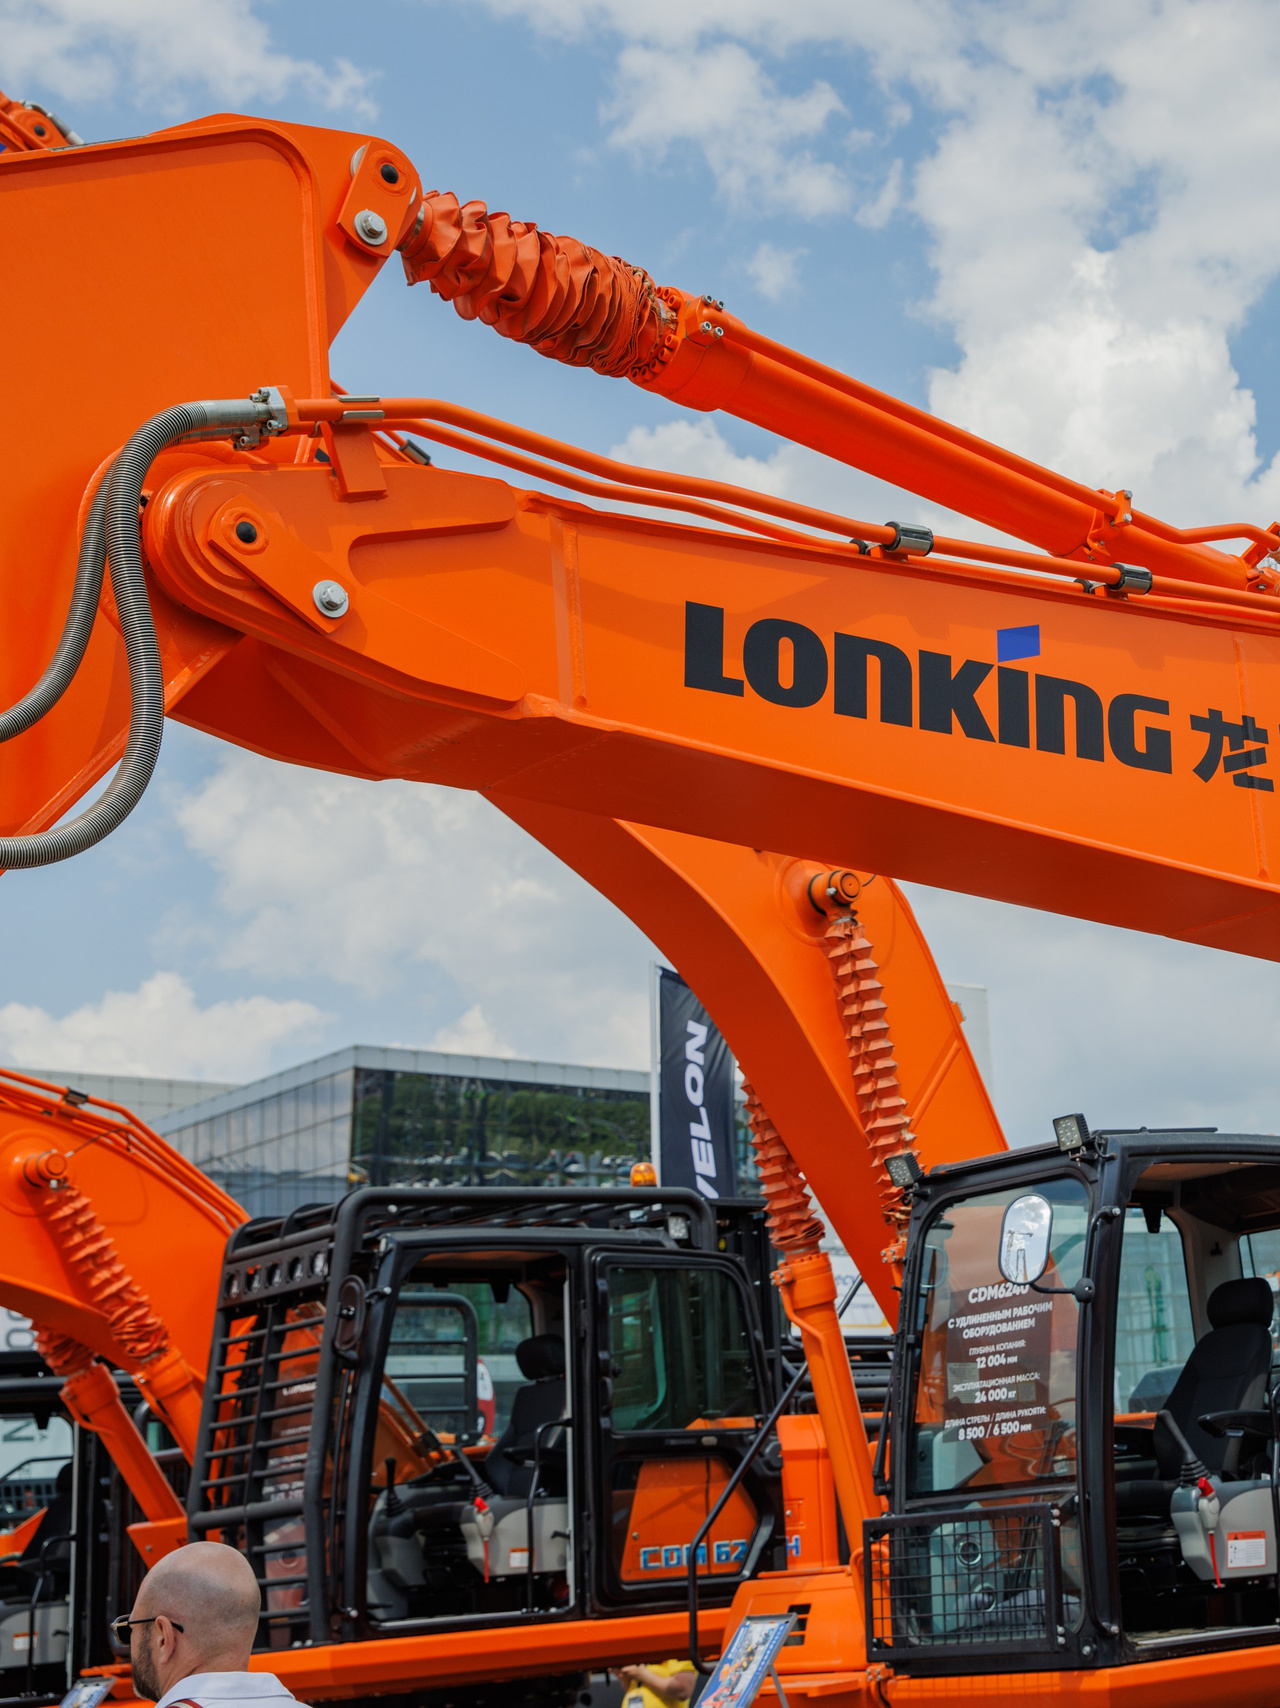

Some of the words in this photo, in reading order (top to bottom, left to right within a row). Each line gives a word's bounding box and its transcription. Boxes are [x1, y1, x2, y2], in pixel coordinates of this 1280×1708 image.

[955, 1309, 1012, 1328] УДЛИНЕННЫМ
[1012, 1301, 1053, 1317] РАБОЧИМ
[963, 1317, 1036, 1339] ОБОРУДОВАНИЕМ
[968, 1345, 995, 1356] ГЛУБИНА
[976, 1357, 986, 1369] 12
[988, 1353, 1006, 1367] 004
[974, 1392, 987, 1403] 24
[988, 1387, 1007, 1401] 000
[966, 1414, 990, 1425] СТРЕЛЫ
[966, 1426, 985, 1439] 500
[1000, 1420, 1020, 1435] 500
